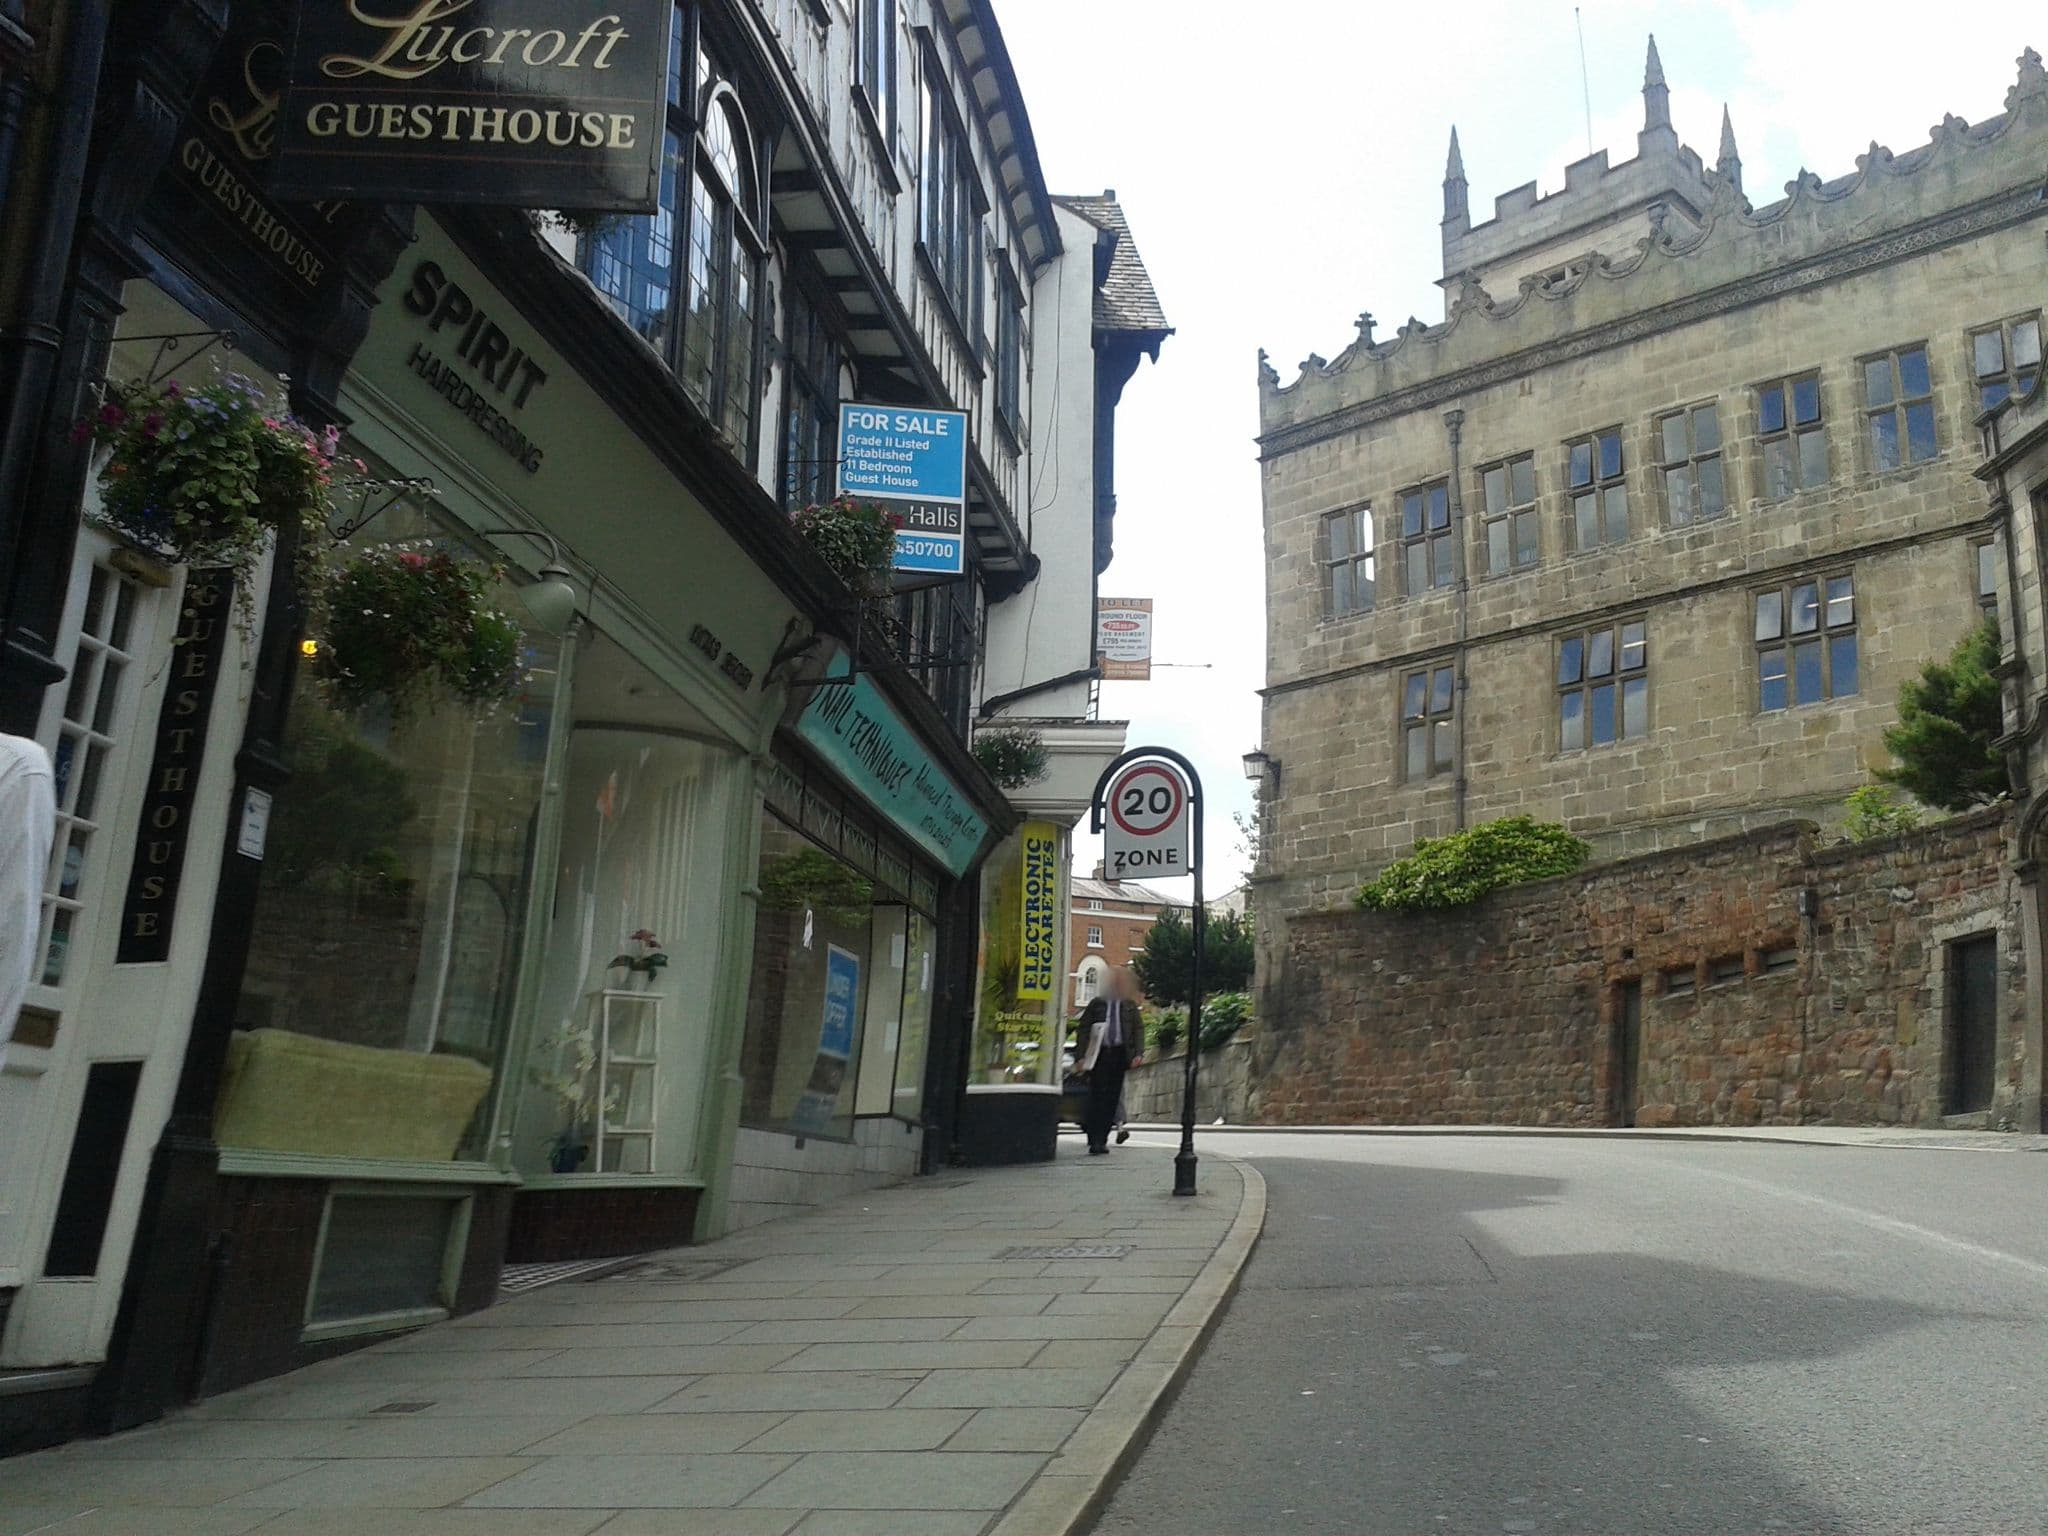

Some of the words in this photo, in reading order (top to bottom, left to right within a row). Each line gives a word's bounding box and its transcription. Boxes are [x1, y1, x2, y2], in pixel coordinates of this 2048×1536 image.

[318, 0, 630, 79] Lucroft
[306, 103, 636, 149] GUESTHOUSE
[183, 138, 324, 287] GUESTHOUSE
[404, 261, 549, 410] SPIRIT
[407, 333, 544, 474] HAIRDRESSING
[847, 434, 882, 446] Grade
[885, 437, 893, 446] II
[895, 438, 930, 450] Listed
[848, 412, 889, 431] FOR
[895, 416, 949, 436] SALE
[846, 447, 913, 461] Established
[846, 459, 857, 470] 11
[859, 461, 912, 474] Bedroom
[845, 471, 879, 484] Guest
[882, 474, 919, 487] House
[909, 505, 958, 527] Halls
[1100, 599, 1116, 607] TO
[1121, 599, 1145, 607] LET
[816, 683, 857, 735] NAIL
[133, 584, 219, 937] GUESTHOUSE
[1123, 786, 1172, 816] 20
[1113, 848, 1179, 867] ZONE
[1023, 838, 1041, 990] ELECTRONIC
[1040, 840, 1055, 991] CIGARETTES
